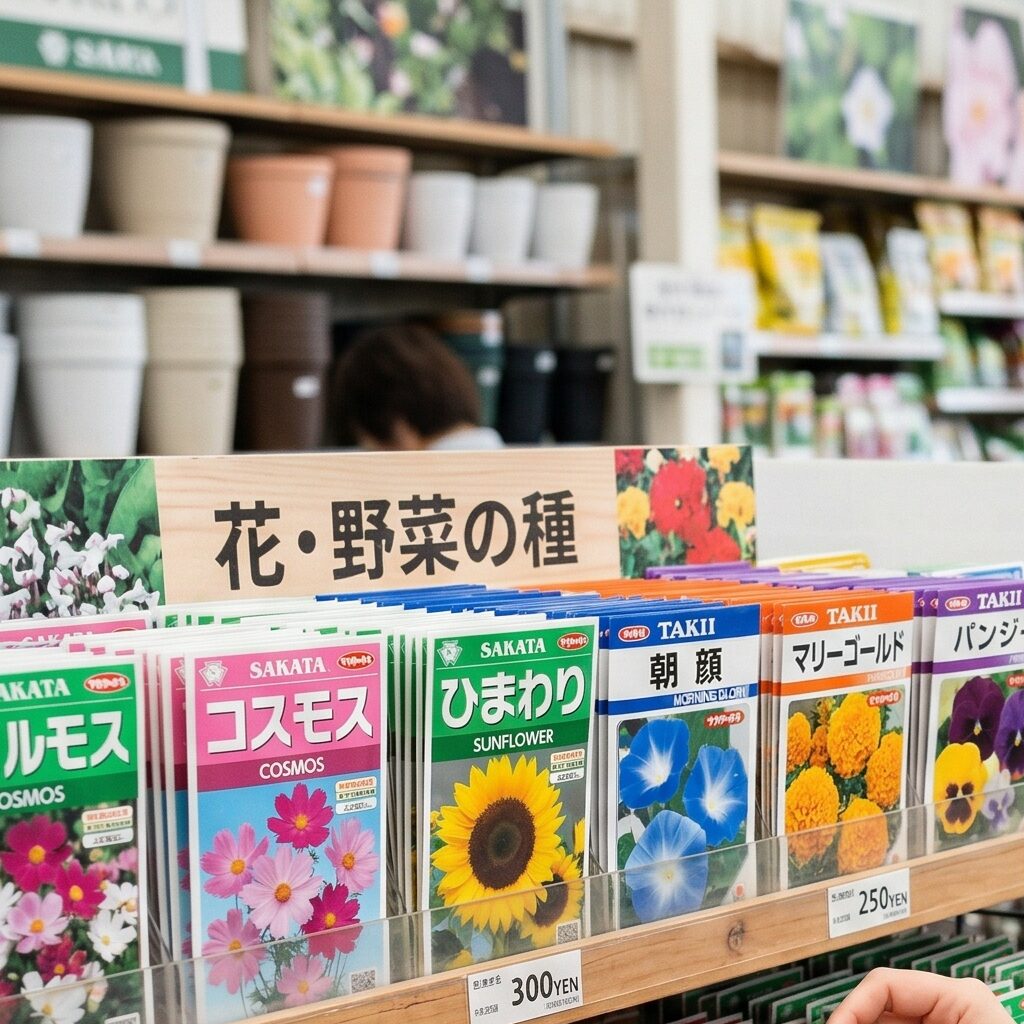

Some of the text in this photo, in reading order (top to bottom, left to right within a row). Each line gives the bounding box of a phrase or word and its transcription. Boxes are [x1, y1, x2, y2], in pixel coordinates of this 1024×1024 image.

[214, 490, 578, 590] 花・野菜の種
[977, 590, 1022, 609] TAKII
[827, 604, 878, 625] TAKII
[657, 618, 716, 640] TAKII
[480, 638, 546, 659] SAKATA
[793, 630, 904, 673] マリーゴールド
[250, 657, 326, 679] SAKATA
[441, 665, 586, 729] ひまわり
[206, 686, 373, 754] コスモス
[4, 711, 130, 780] ルモス
[473, 729, 553, 753] SUNFLOWER
[259, 757, 324, 779] COSMOS
